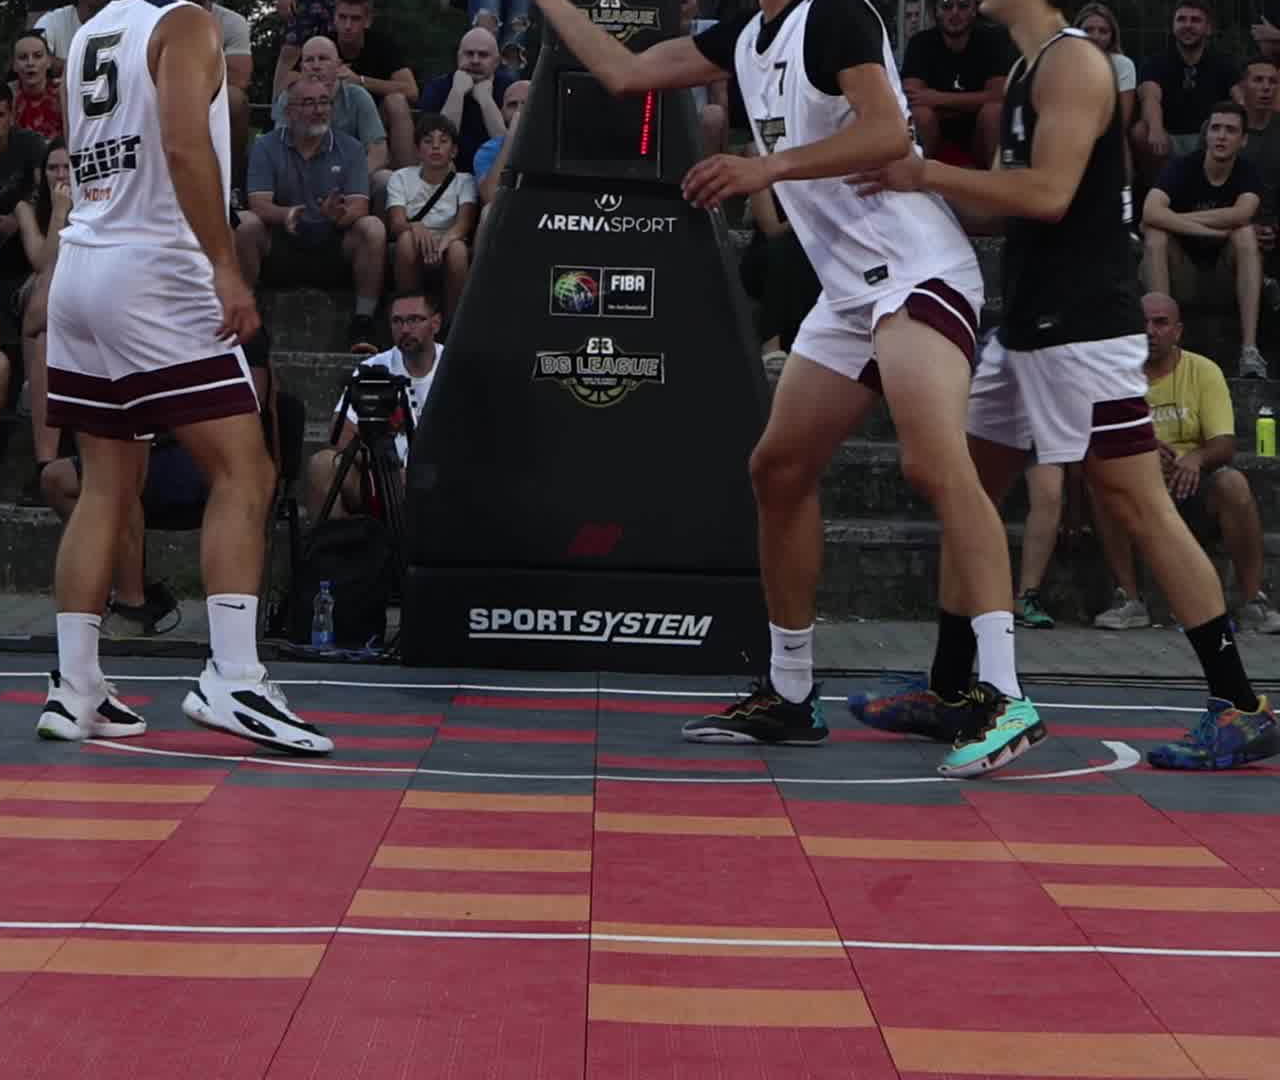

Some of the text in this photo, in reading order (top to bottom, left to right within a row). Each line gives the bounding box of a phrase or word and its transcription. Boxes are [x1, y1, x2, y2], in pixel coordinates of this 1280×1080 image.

[81, 29, 124, 120] 5
[774, 61, 788, 96] 7
[537, 213, 678, 233] ARENASPORT
[611, 275, 645, 291] FIBA
[576, 357, 660, 376] LEAGUE
